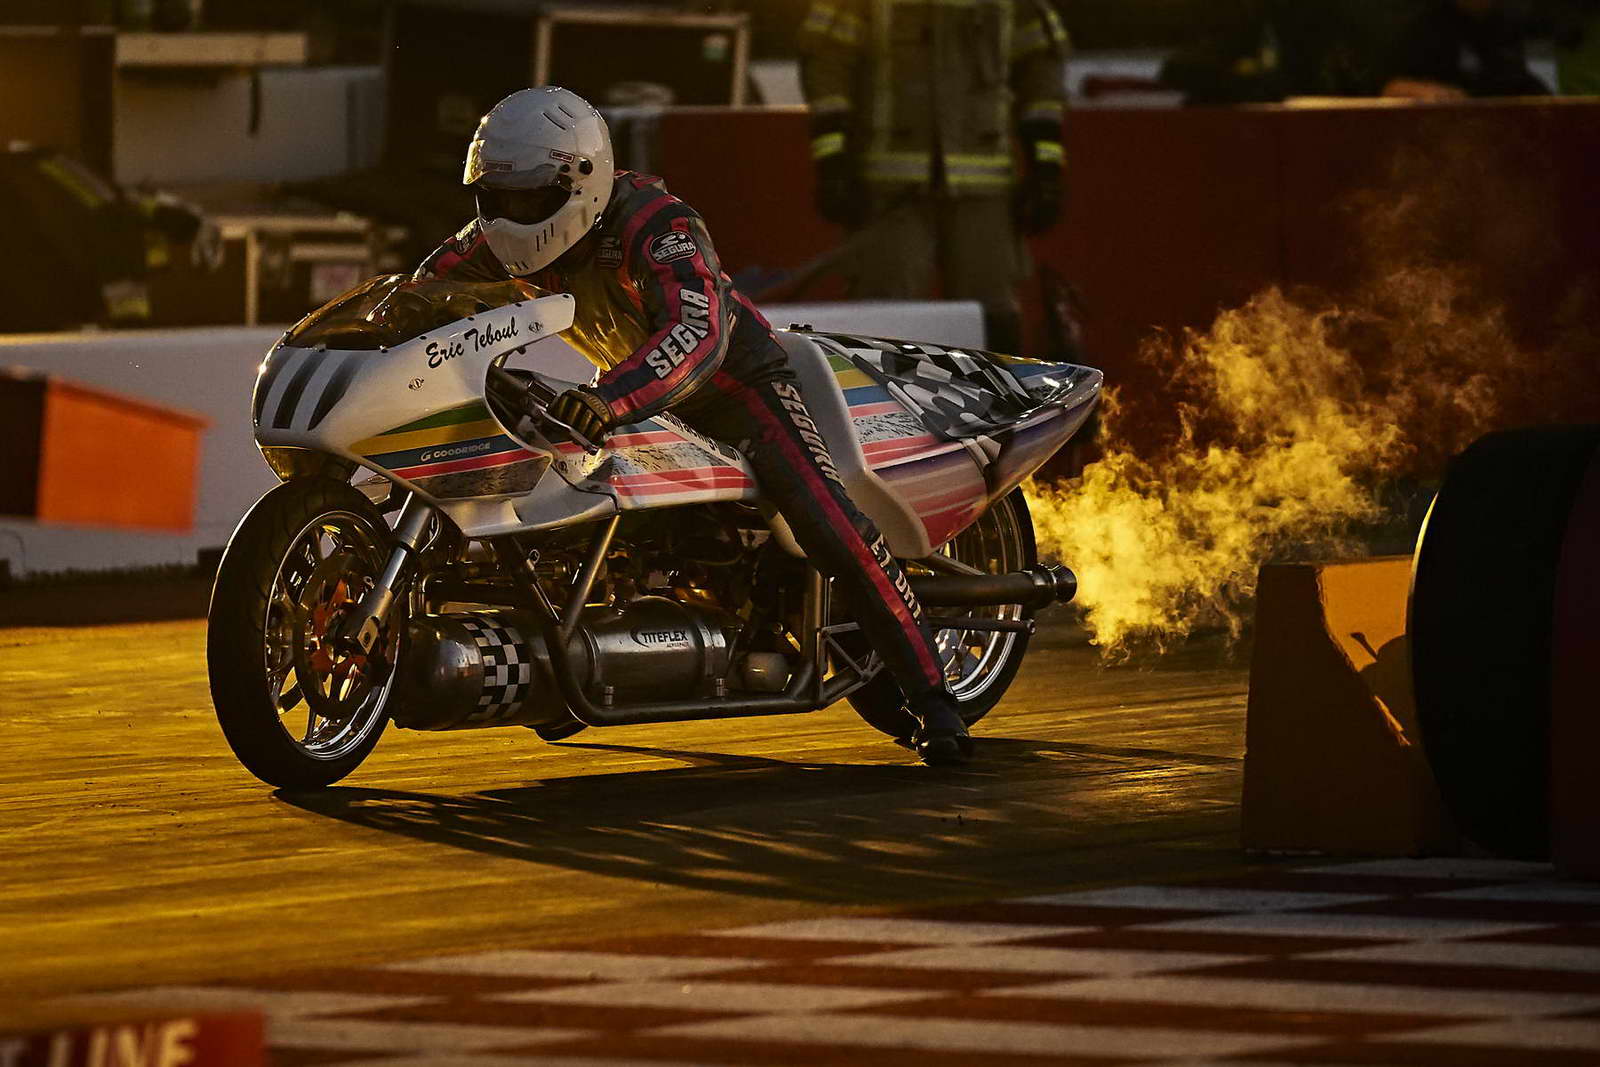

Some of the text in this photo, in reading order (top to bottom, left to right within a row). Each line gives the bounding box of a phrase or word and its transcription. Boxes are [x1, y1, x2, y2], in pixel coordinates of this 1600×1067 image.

[653, 242, 696, 261] SEGURA
[425, 316, 519, 369] Eric Teboul
[433, 441, 491, 459] GOODRIDGE
[641, 631, 688, 643] TITEFLEX
